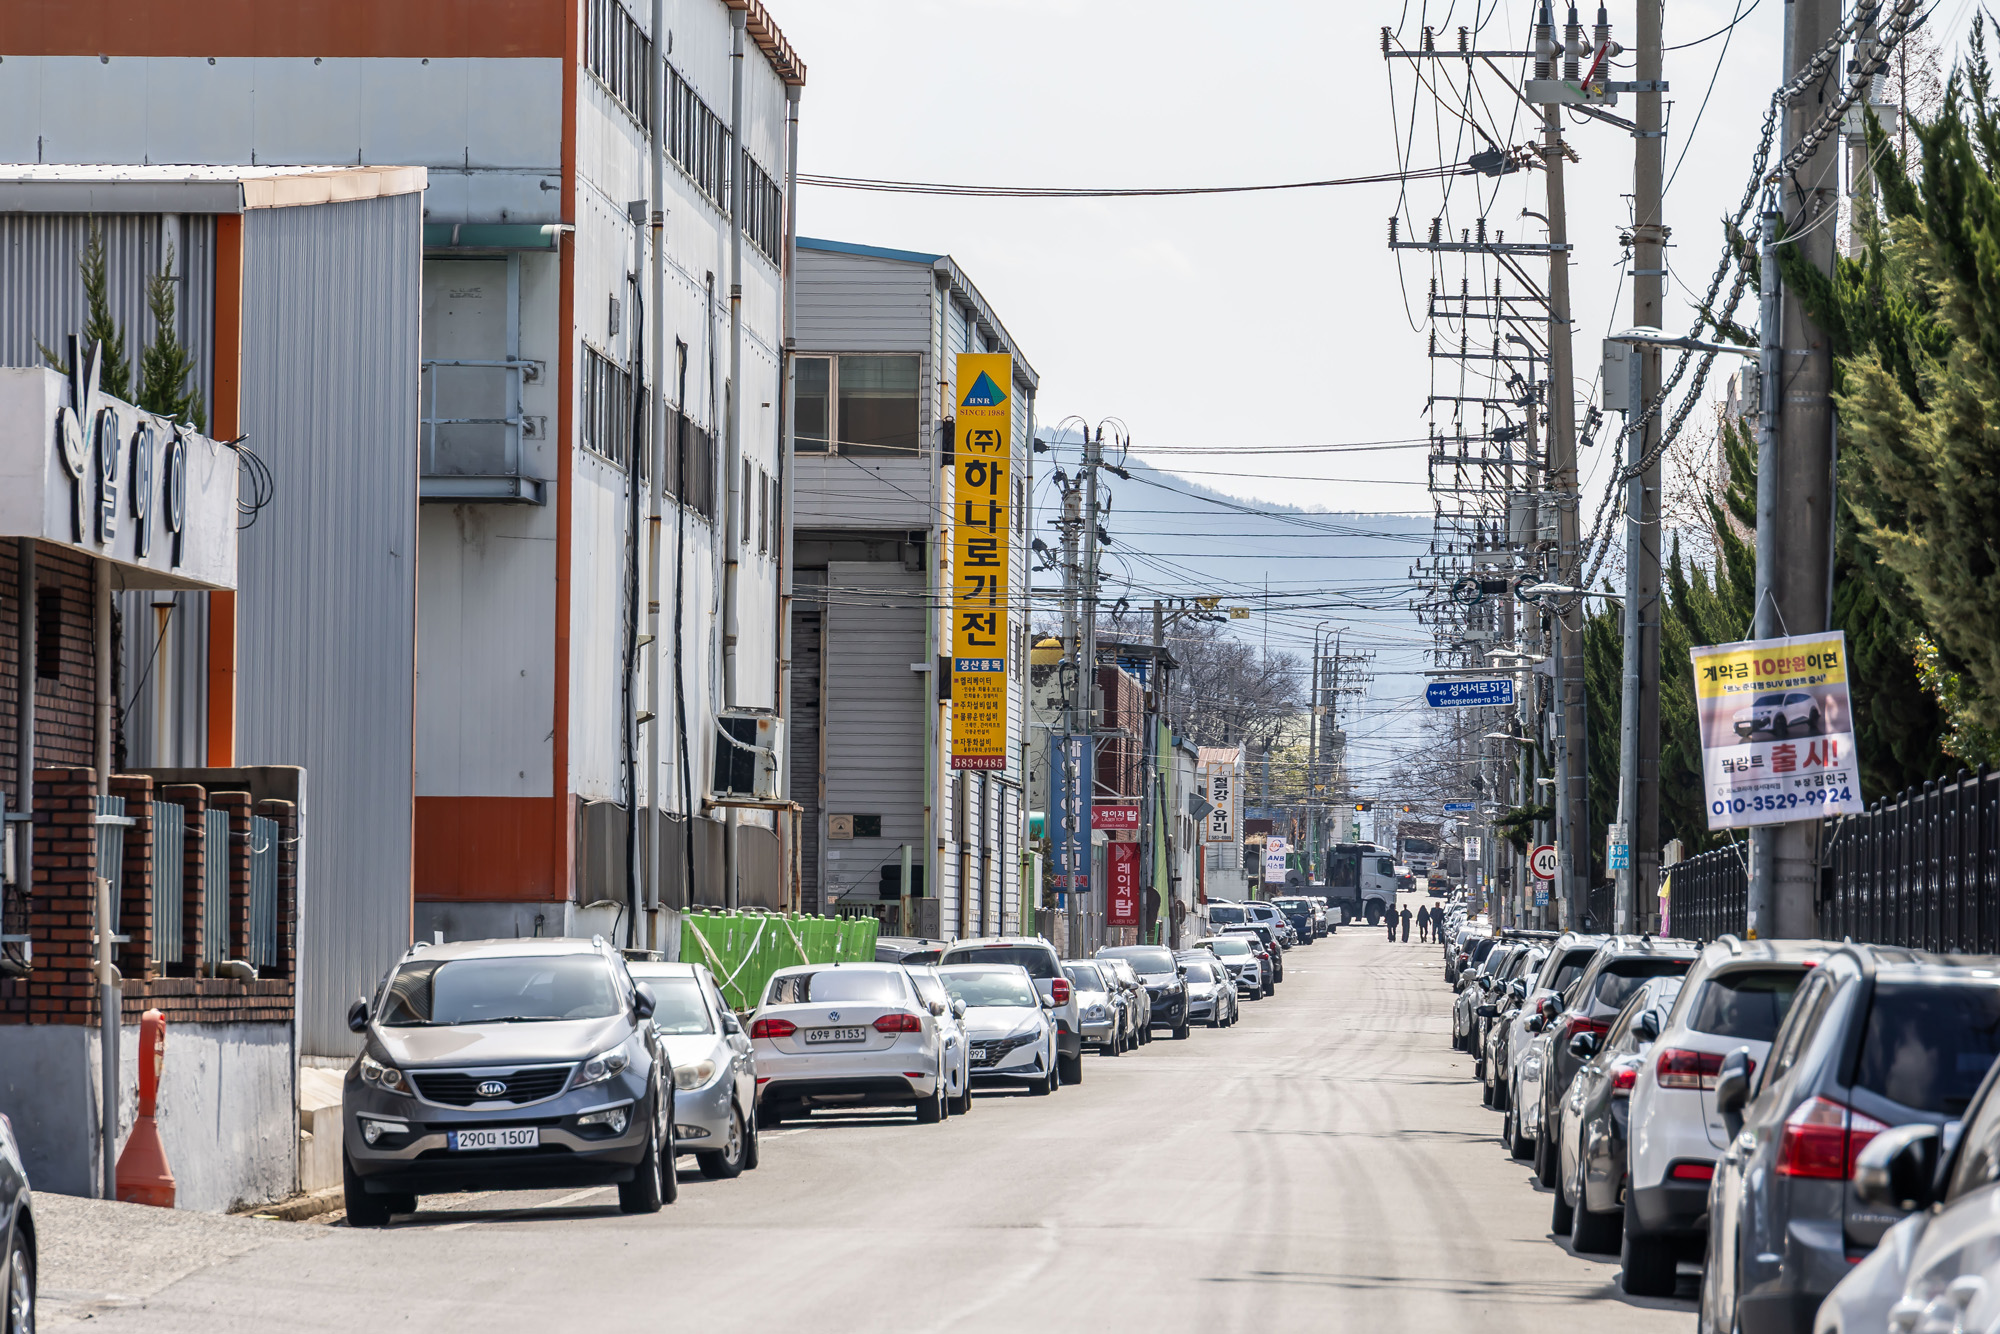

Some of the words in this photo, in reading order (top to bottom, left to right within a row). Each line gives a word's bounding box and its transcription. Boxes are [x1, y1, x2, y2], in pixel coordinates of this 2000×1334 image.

[960, 659, 1001, 671] 생산품목
[1703, 662, 1749, 682] 계약금
[1752, 652, 1838, 677] 10만원이면
[1765, 680, 1784, 689] SUV
[1440, 696, 1491, 706] Seongseoseo-ro
[1492, 695, 1511, 704] 51-gil
[960, 712, 998, 722] 물류운반설비
[960, 738, 992, 747] 자동화설비
[954, 758, 1003, 768] 583-0485
[1721, 754, 1764, 774] 필랑트
[1794, 778, 1811, 788] 부장
[1813, 772, 1848, 787] 김인규
[1712, 786, 1852, 815] 010-3529-9924
[1101, 810, 1125, 818] 레이저
[1126, 810, 1138, 822] 탑
[1538, 855, 1556, 870] 40
[1117, 863, 1131, 898] 레이저
[1115, 899, 1134, 916] 탑
[834, 1029, 860, 1039] 8153
[481, 1084, 501, 1093] KIA
[500, 1130, 535, 1145] 1507
